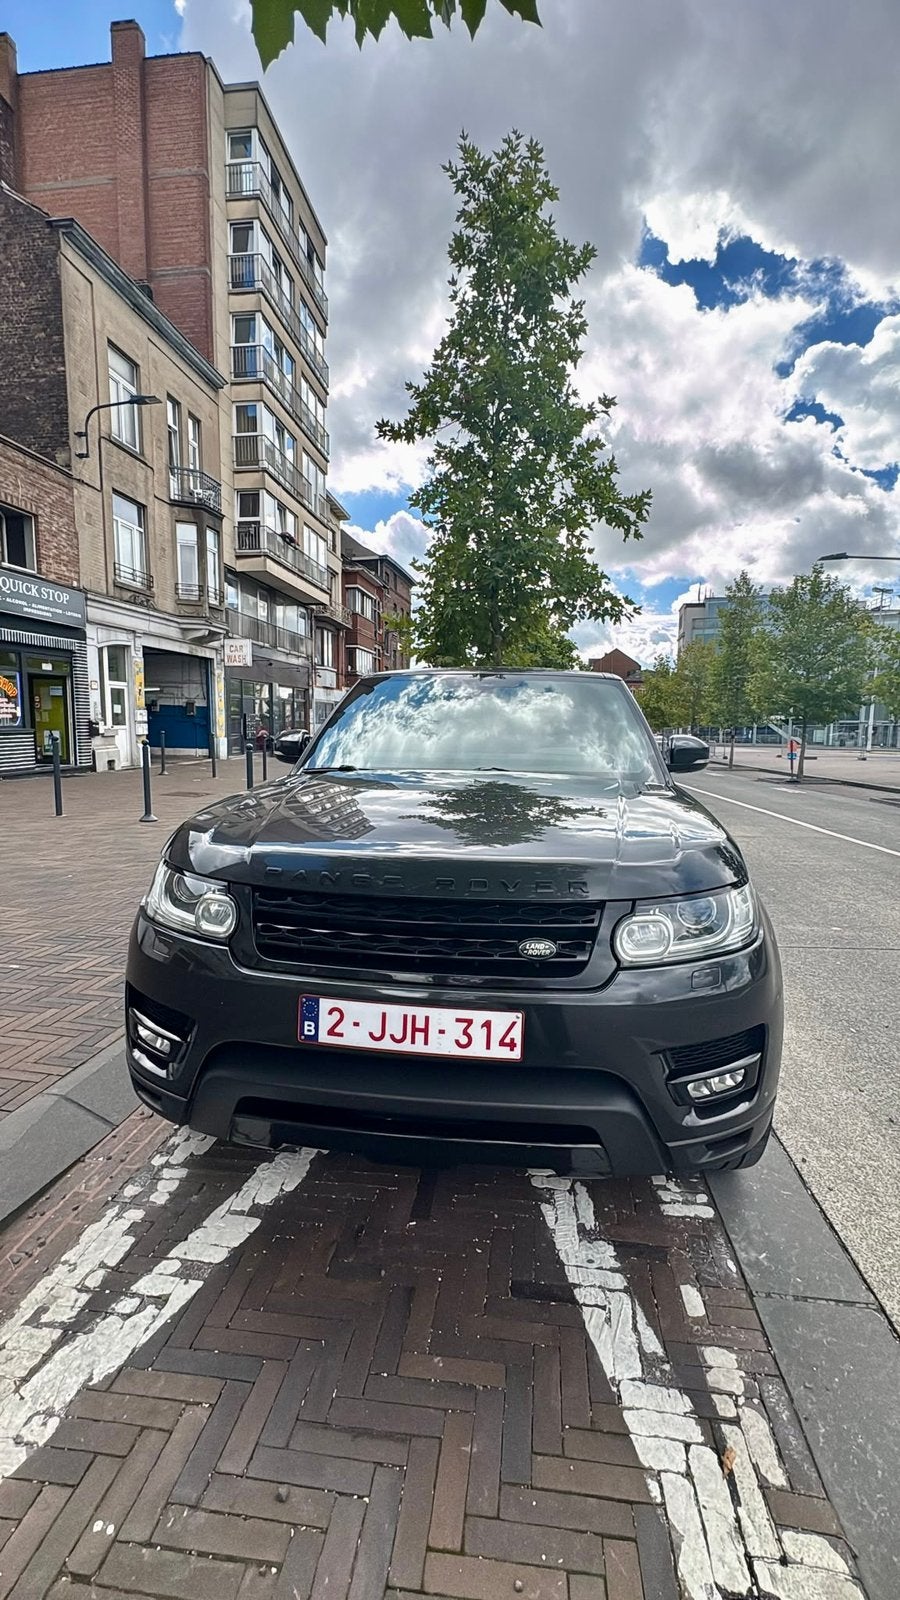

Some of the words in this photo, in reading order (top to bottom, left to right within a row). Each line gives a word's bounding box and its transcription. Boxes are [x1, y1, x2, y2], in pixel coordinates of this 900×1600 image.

[0, 576, 40, 598] QUICK
[41, 587, 70, 604] STOP
[229, 645, 244, 653] CAR
[227, 655, 247, 663] WASH
[435, 877, 590, 895] ROVER
[303, 1020, 316, 1036] B
[326, 1006, 518, 1052] 2-JJH-314
